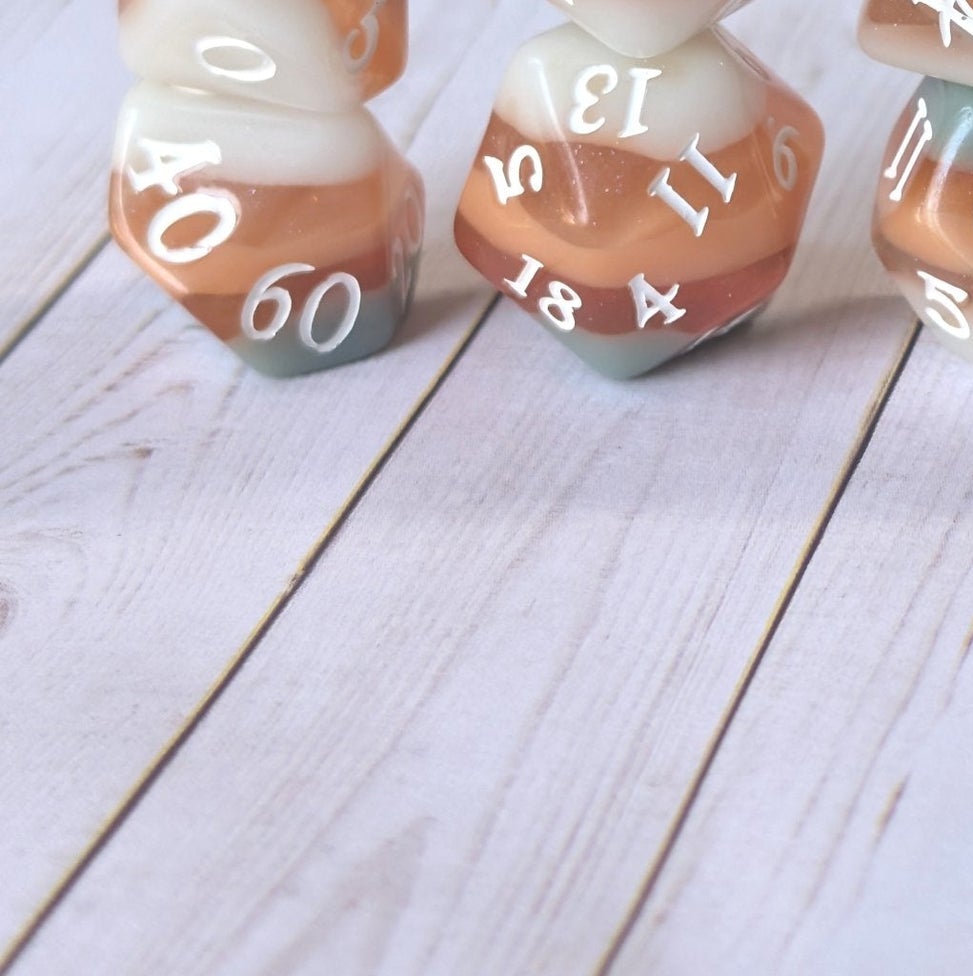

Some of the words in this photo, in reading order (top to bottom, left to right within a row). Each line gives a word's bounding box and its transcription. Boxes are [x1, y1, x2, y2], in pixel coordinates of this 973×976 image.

[196, 36, 277, 81] 0
[569, 64, 662, 138] 13
[128, 137, 241, 264] 40
[483, 144, 543, 205] 5
[649, 133, 737, 237] 11
[241, 262, 361, 352] 60
[504, 254, 582, 331] 18
[628, 273, 686, 328] 4
[917, 270, 970, 340] 5
